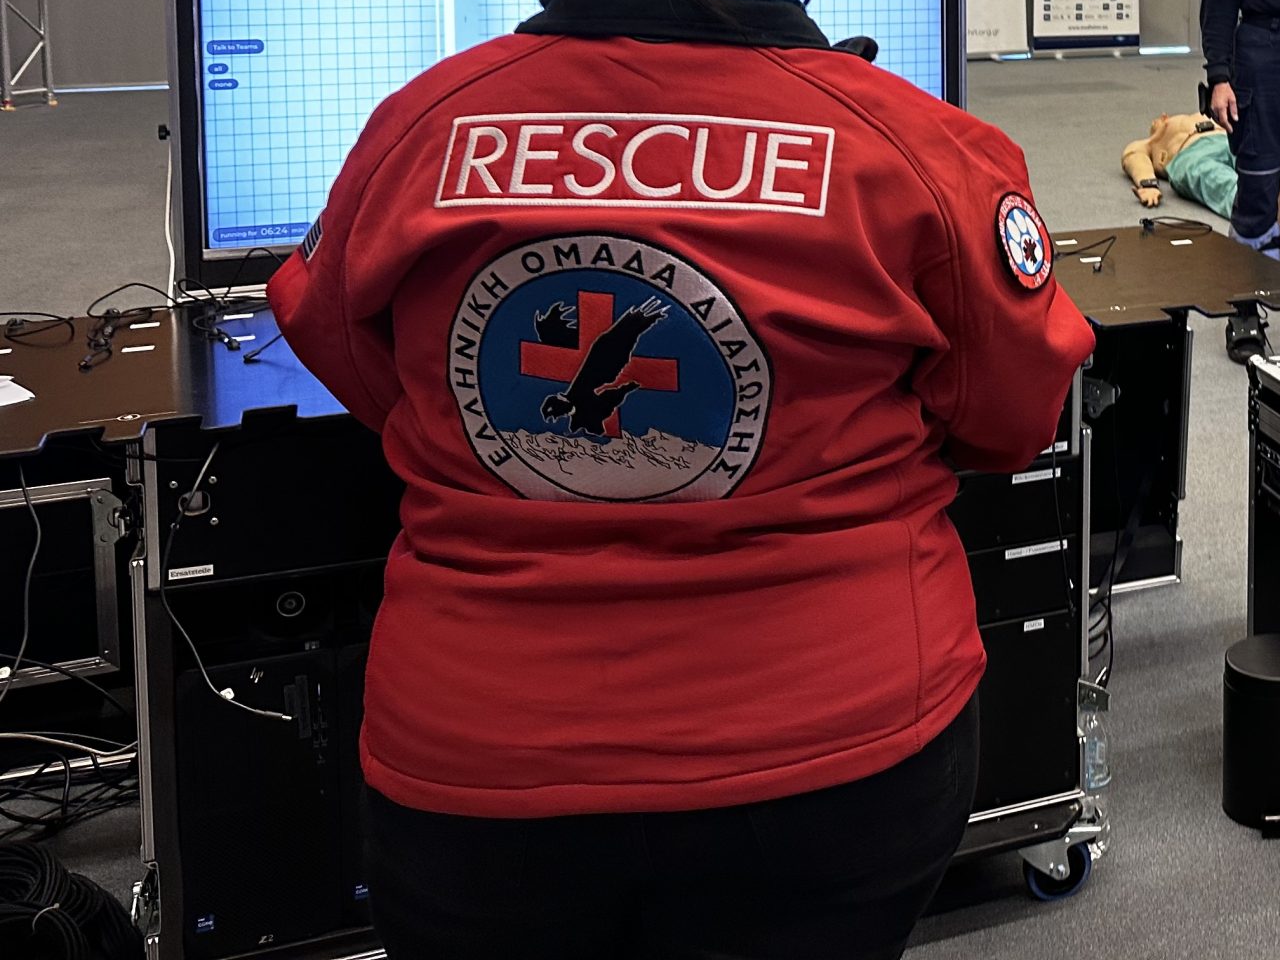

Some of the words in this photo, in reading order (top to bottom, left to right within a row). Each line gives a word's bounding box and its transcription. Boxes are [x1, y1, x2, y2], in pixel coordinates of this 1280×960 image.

[455, 124, 813, 204] RESCUE
[220, 231, 247, 239] running
[455, 272, 513, 467] ΕΛΛΗΝΙΚΗ
[521, 243, 676, 290] ΟΜΑΔΑ
[690, 297, 761, 479] ΔΙΑΣΩΣΗΣ
[170, 567, 211, 578] Ersatzteile
